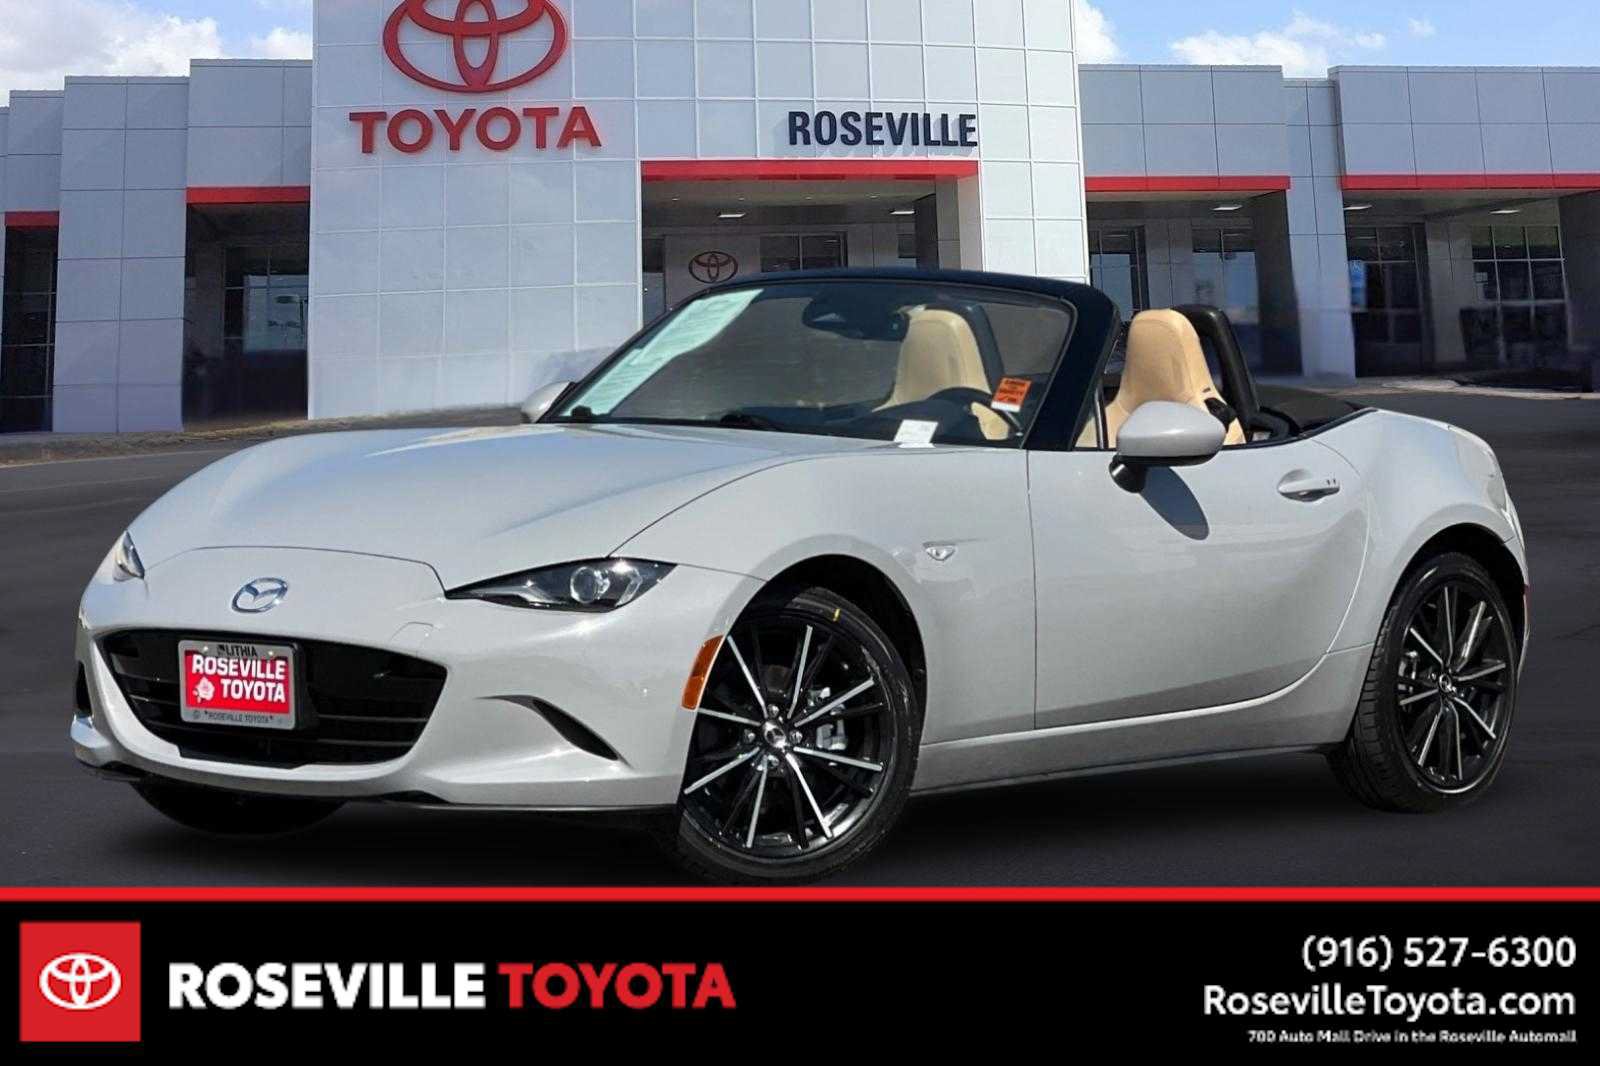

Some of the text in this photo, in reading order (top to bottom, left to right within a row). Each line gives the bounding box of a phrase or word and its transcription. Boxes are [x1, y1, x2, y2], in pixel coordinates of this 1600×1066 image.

[350, 106, 602, 153] TOYOTA
[789, 111, 978, 147] ROSEVILLE
[225, 644, 258, 657] LITHIA
[192, 654, 286, 680] ROSEVILLE
[220, 678, 286, 703] TOYOTA
